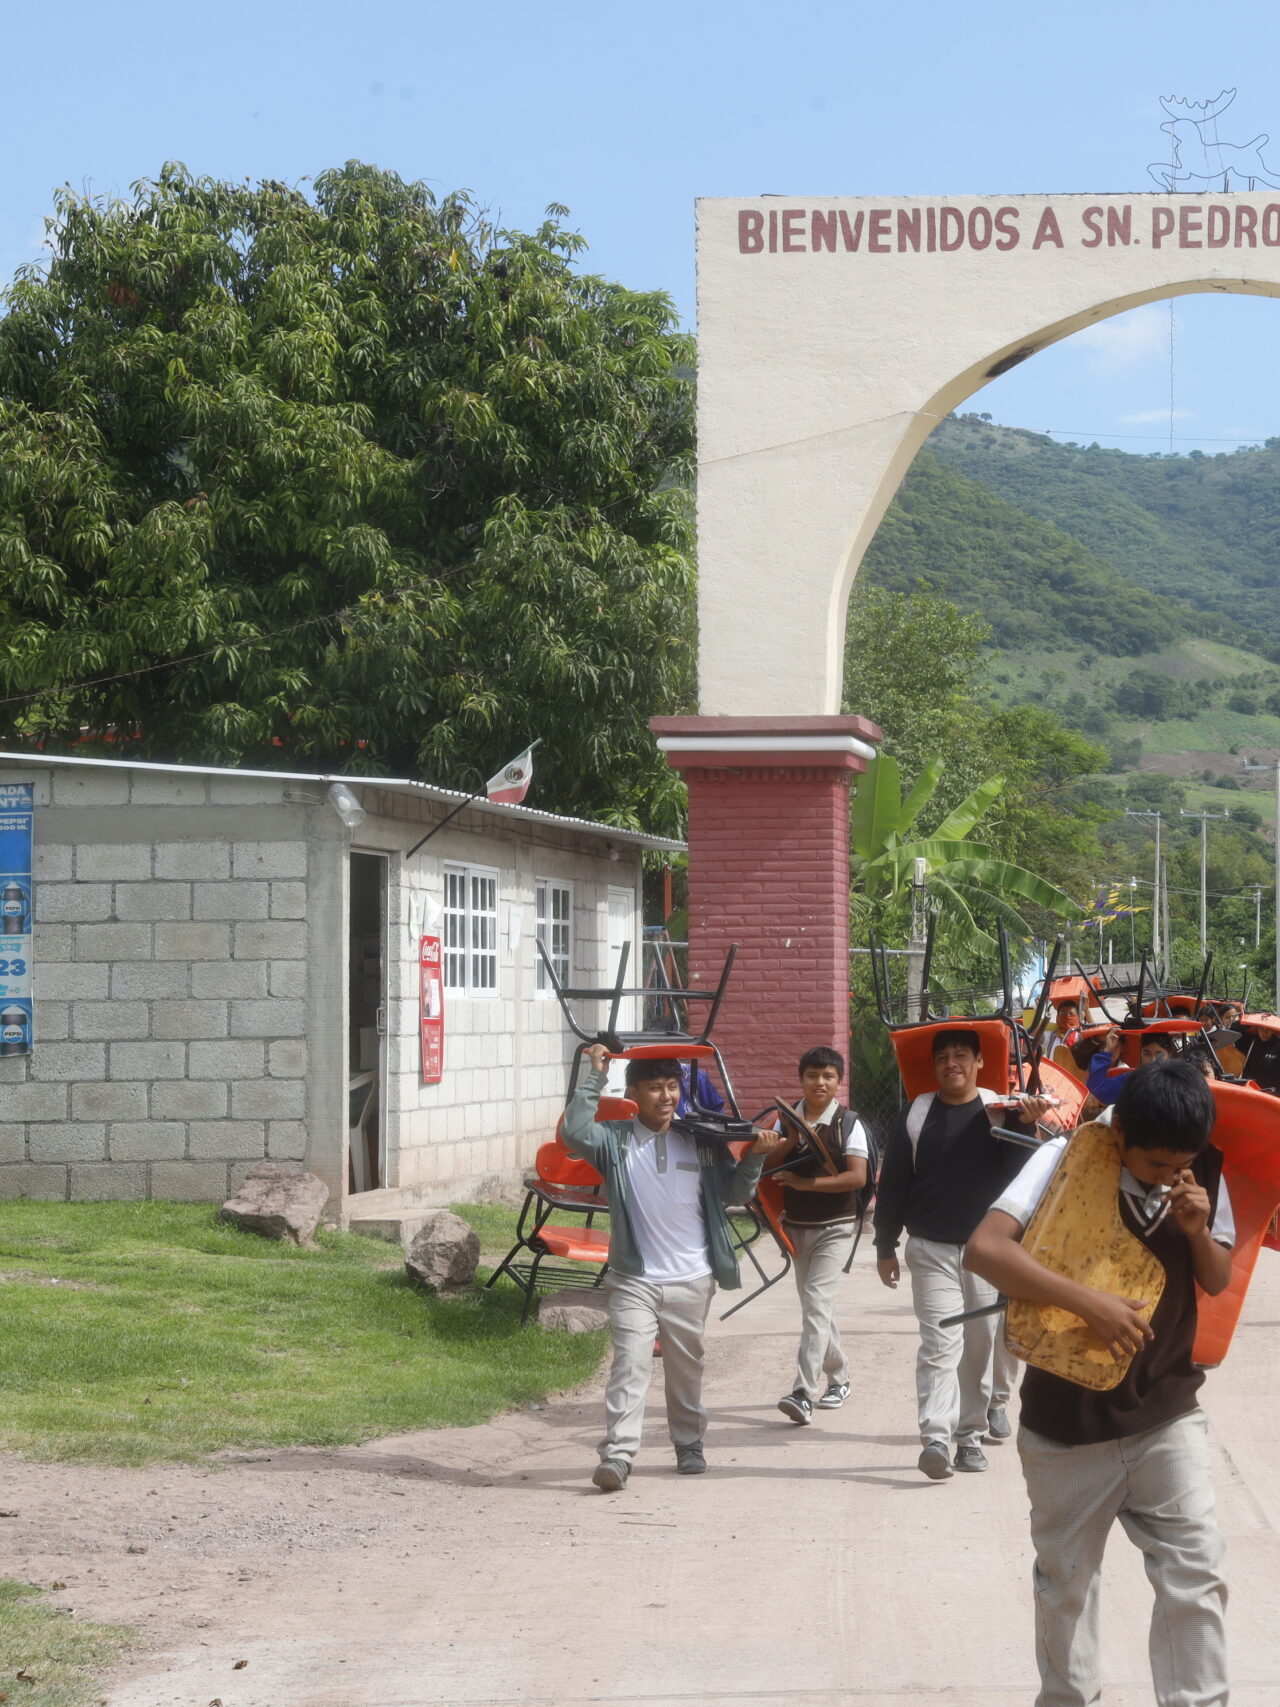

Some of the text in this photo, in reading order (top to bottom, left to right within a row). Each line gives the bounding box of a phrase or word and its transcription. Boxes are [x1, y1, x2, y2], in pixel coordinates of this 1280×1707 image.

[738, 206, 1020, 254] BIENVENIDOS
[1032, 206, 1064, 250] A
[1081, 205, 1141, 248] SN.
